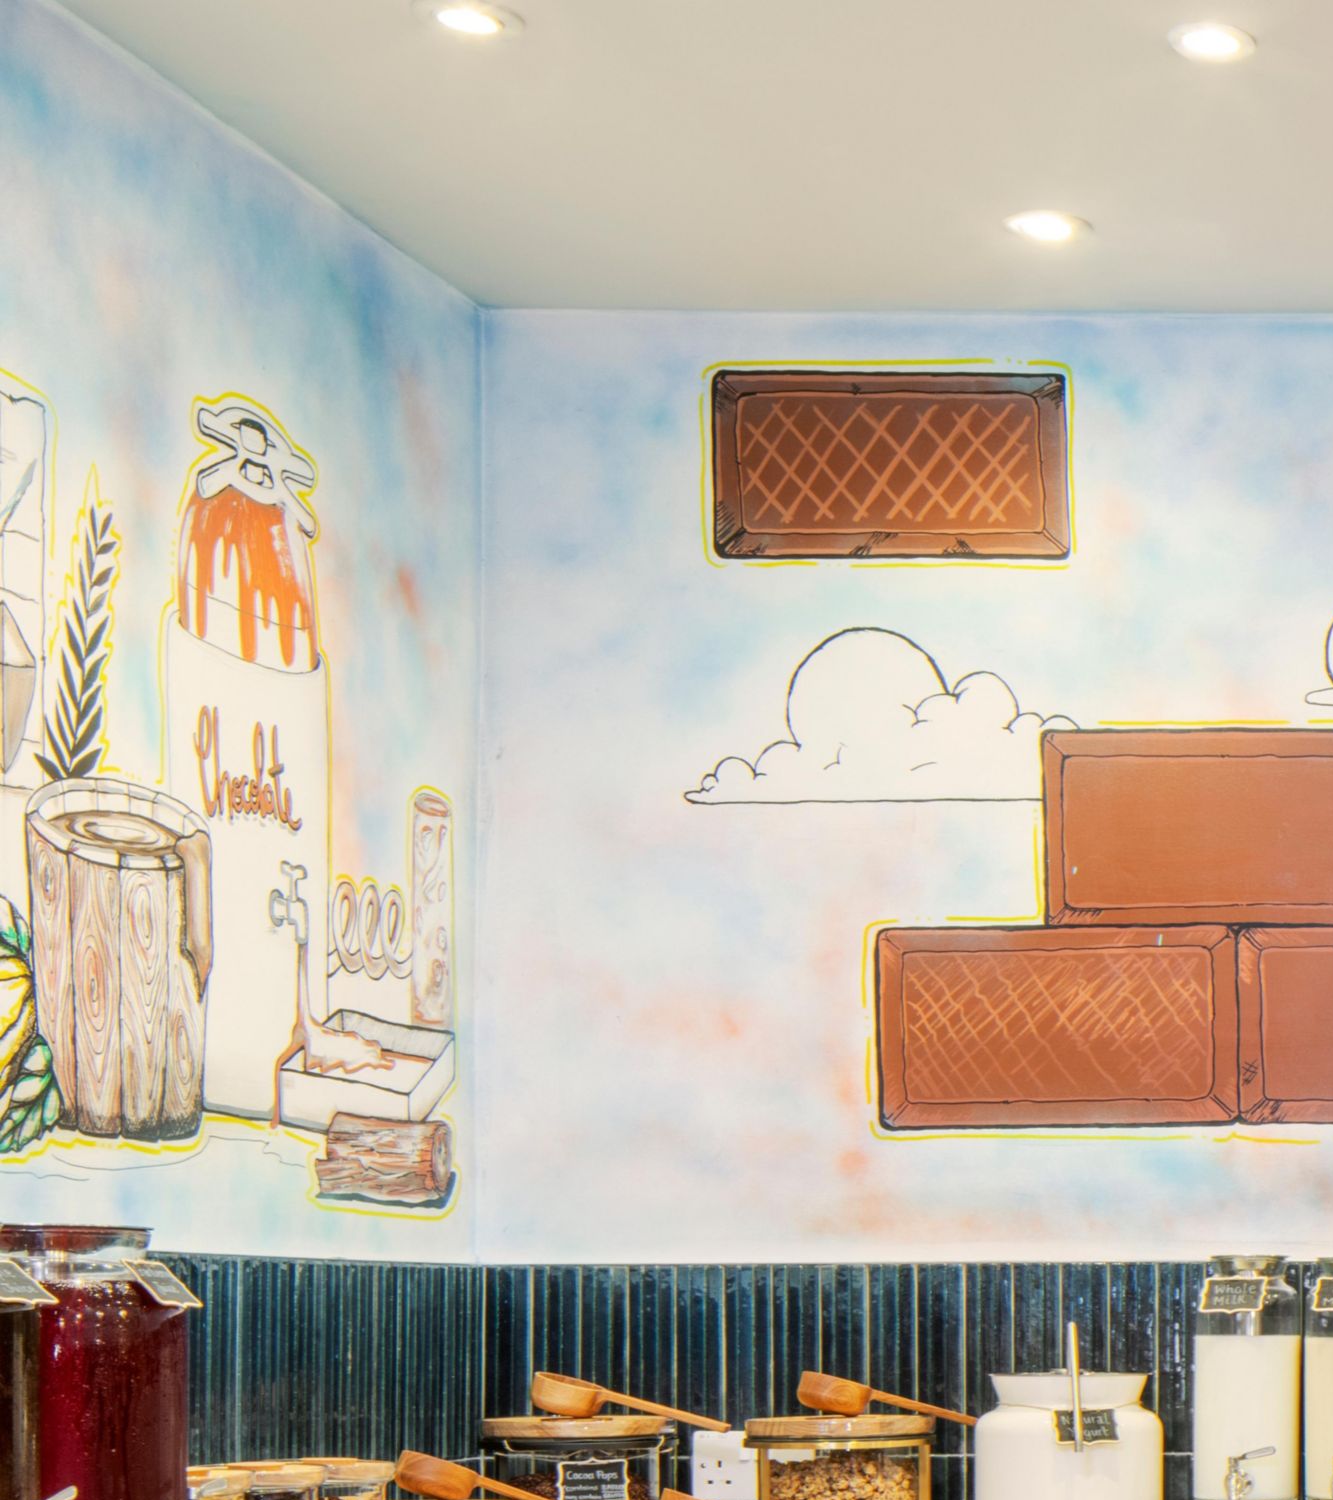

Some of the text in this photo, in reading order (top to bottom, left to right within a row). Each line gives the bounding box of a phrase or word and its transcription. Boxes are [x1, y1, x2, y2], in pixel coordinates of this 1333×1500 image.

[193, 705, 302, 832] Chocolate
[1214, 1282, 1256, 1294] Whole
[1060, 1412, 1111, 1425] Nural
[566, 1470, 618, 1481] Cocoa Pops
